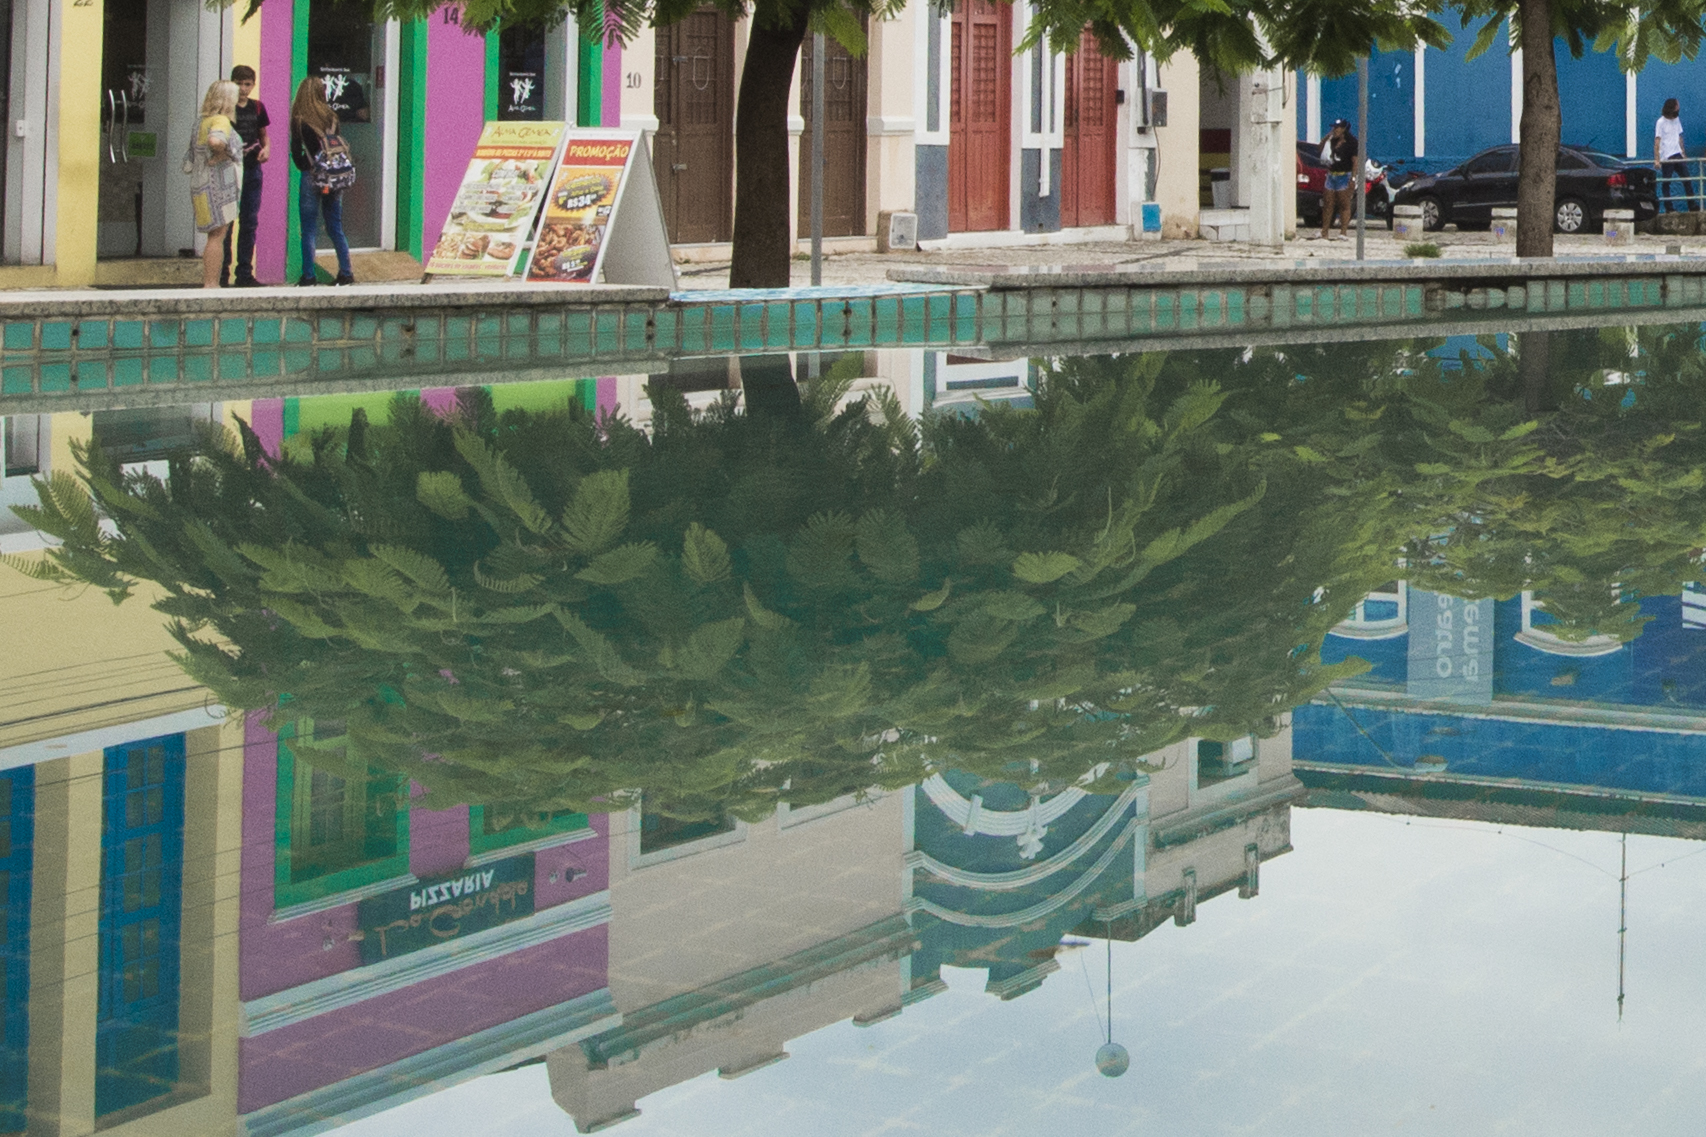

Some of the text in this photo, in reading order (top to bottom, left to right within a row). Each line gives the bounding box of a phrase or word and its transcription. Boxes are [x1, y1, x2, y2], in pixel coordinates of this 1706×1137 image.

[443, 7, 459, 24] 14
[627, 72, 641, 89] 10
[569, 144, 629, 161] PROMOÇÃO
